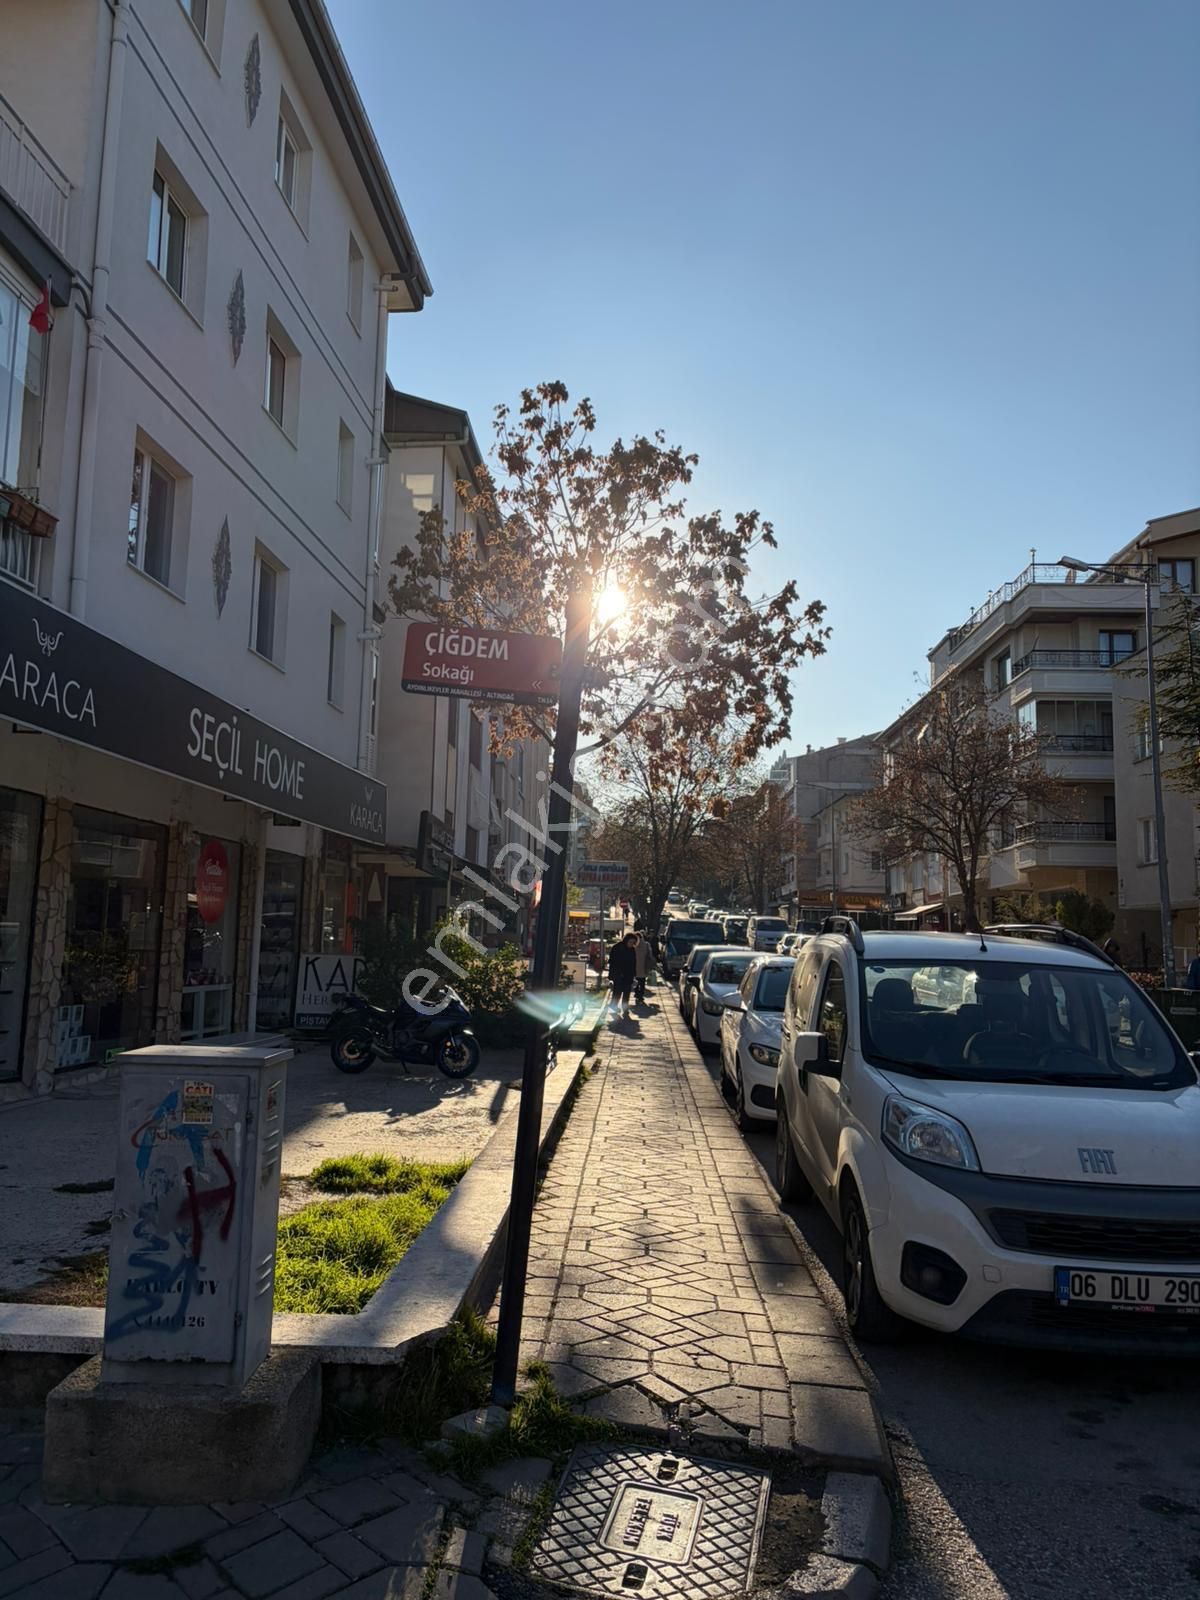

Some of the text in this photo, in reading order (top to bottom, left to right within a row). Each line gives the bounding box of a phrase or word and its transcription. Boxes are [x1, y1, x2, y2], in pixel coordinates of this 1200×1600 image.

[425, 627, 509, 660] ÇİĞDEM
[422, 662, 474, 685] Sokağı
[187, 707, 305, 800] SEÇİL HOME
[350, 802, 384, 834] KARACA
[1077, 1148, 1118, 1175] FIAT
[1059, 1286, 1069, 1294] TR
[1071, 1273, 1200, 1304] 06 DLU 290
[622, 1497, 652, 1550] TELEKOM
[656, 1512, 682, 1543] TÜRK
